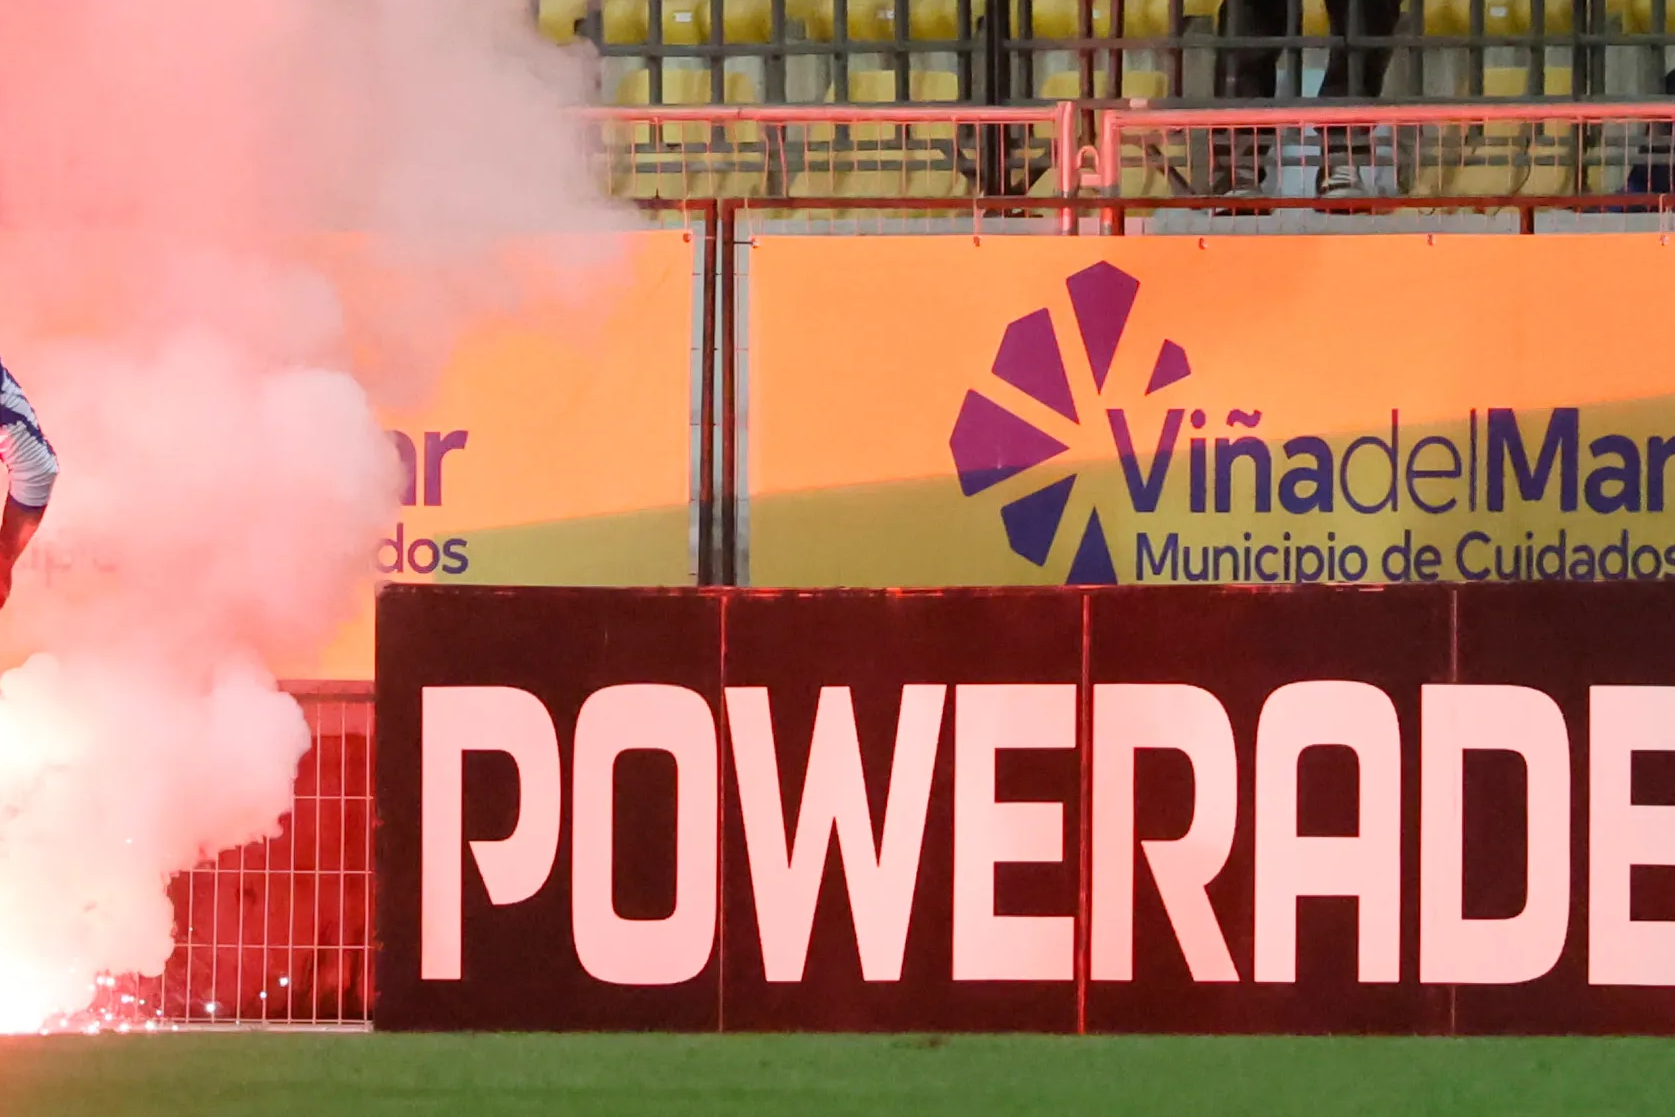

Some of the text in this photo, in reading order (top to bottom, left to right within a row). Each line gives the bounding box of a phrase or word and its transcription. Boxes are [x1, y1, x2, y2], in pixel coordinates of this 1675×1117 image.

[1135, 531, 1368, 583] Municipio
[1381, 528, 1444, 582] de
[420, 680, 1675, 986] POWERADE
